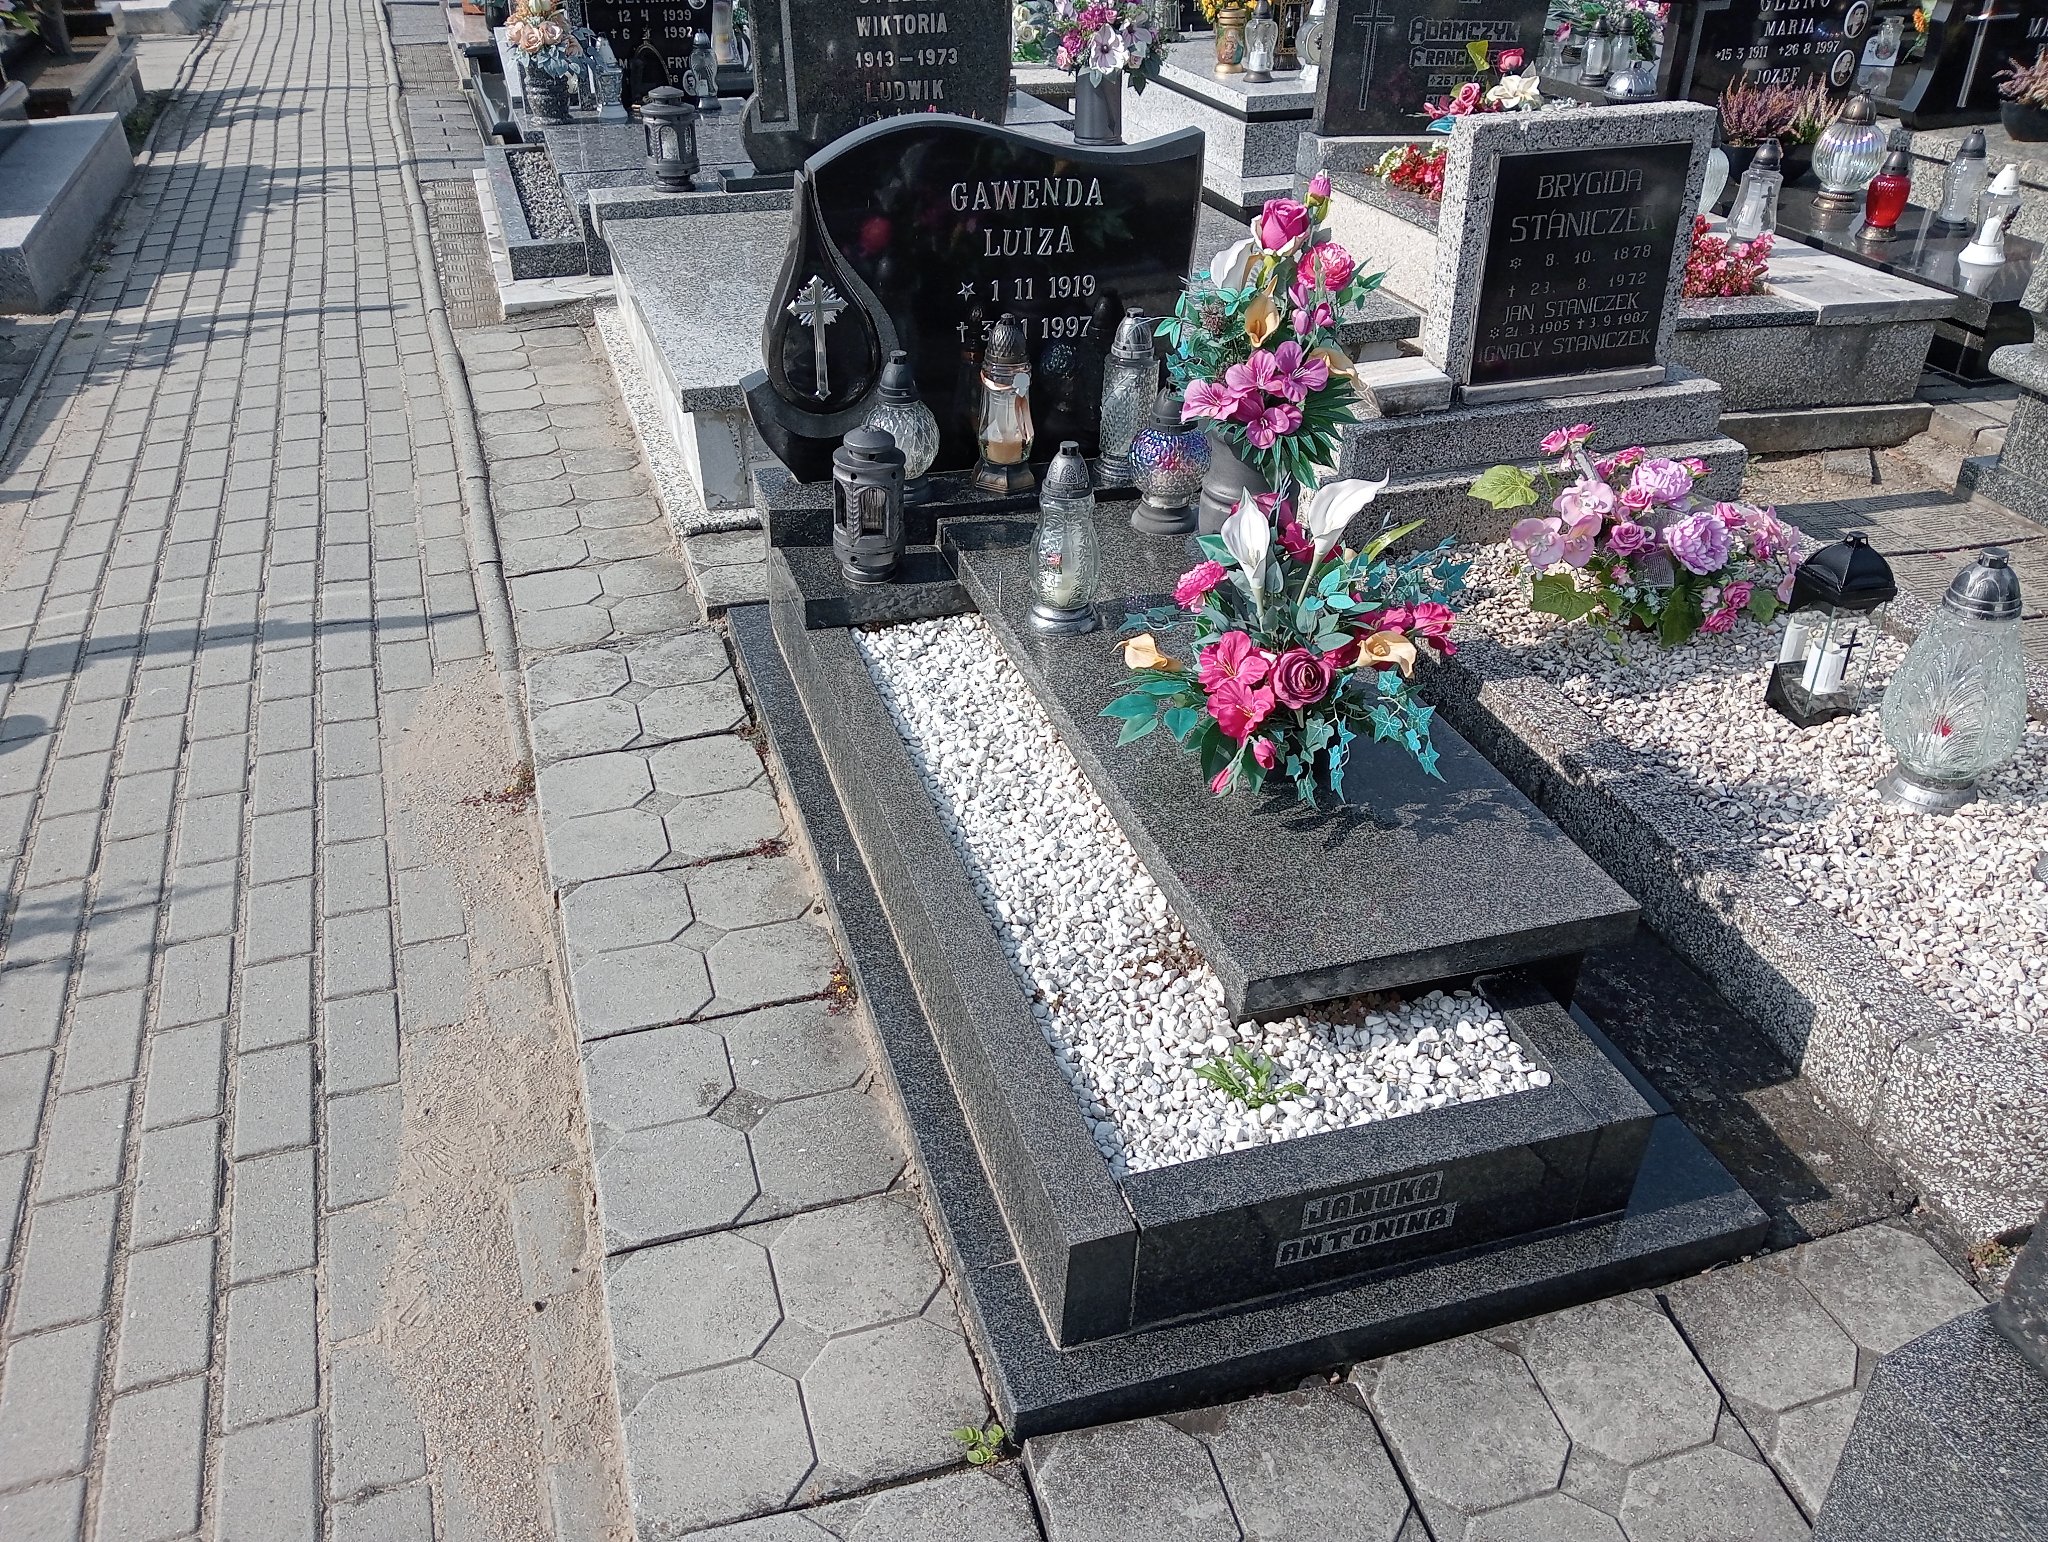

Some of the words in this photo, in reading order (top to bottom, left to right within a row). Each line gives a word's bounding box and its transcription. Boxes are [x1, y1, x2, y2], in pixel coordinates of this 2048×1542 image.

[618, 9, 632, 23] 12
[663, 9, 692, 22] 1939
[856, 13, 947, 37] WIKTORIA
[1764, 17, 1814, 37] MARIA
[1409, 16, 1521, 44] ADAMCZYK
[1736, 47, 1744, 60] 3
[1748, 45, 1769, 59] 1911
[1803, 42, 1811, 55] 8
[1815, 40, 1841, 55] 1997
[866, 79, 944, 103] LUDWIK
[951, 177, 1104, 211] GAWENDA
[1536, 168, 1644, 200] BRYGIDA
[983, 225, 1074, 257] LUIZA
[1613, 244, 1652, 261] 1878
[991, 279, 999, 302] 1
[1014, 278, 1033, 300] 11
[1049, 275, 1096, 298] 1919
[1609, 271, 1647, 288] 1972
[1503, 305, 1535, 325] JAN
[1545, 292, 1640, 318] STANICZEK
[1041, 316, 1093, 339] 1997
[1478, 340, 1543, 363] IGNACY
[1552, 328, 1652, 355] STANICZEK
[1303, 1172, 1441, 1228] JANUKA
[1277, 1204, 1453, 1266] ANTONINA
